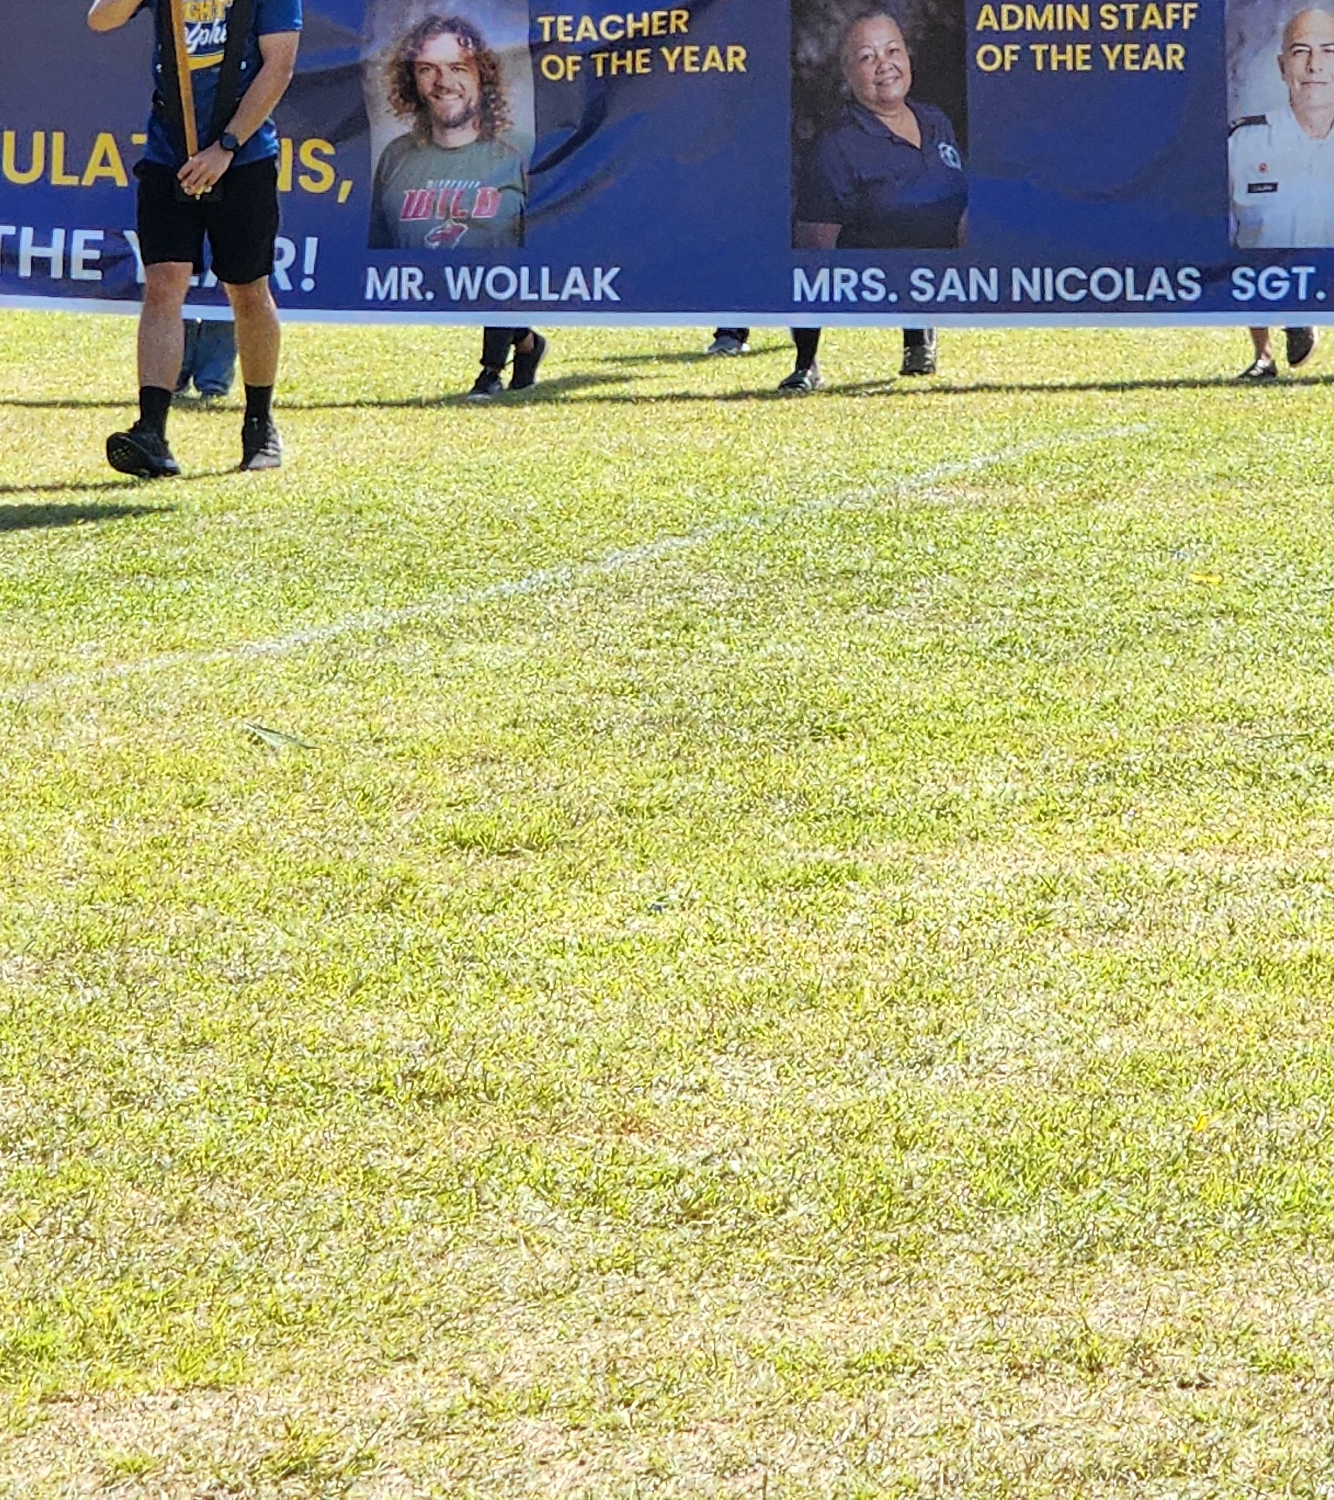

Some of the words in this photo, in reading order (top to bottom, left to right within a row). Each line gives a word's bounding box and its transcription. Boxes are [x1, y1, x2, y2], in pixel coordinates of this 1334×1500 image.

[538, 9, 689, 43] TEACHER
[976, 4, 1090, 32] ADMIN
[1099, 3, 1199, 31] STAFF
[541, 53, 575, 82] OF
[592, 50, 651, 77] THE
[661, 45, 748, 74] YEAR
[976, 43, 1024, 72] OF
[1029, 43, 1092, 71] THE
[1101, 43, 1185, 71] YEAR
[400, 186, 502, 221] WILD
[365, 266, 434, 302] MR.
[444, 266, 622, 302] WOLLAK
[793, 267, 898, 303] MRS.
[909, 267, 999, 302] SAN
[1011, 266, 1202, 302] NICOLAS
[1231, 265, 1325, 301] SGT.
